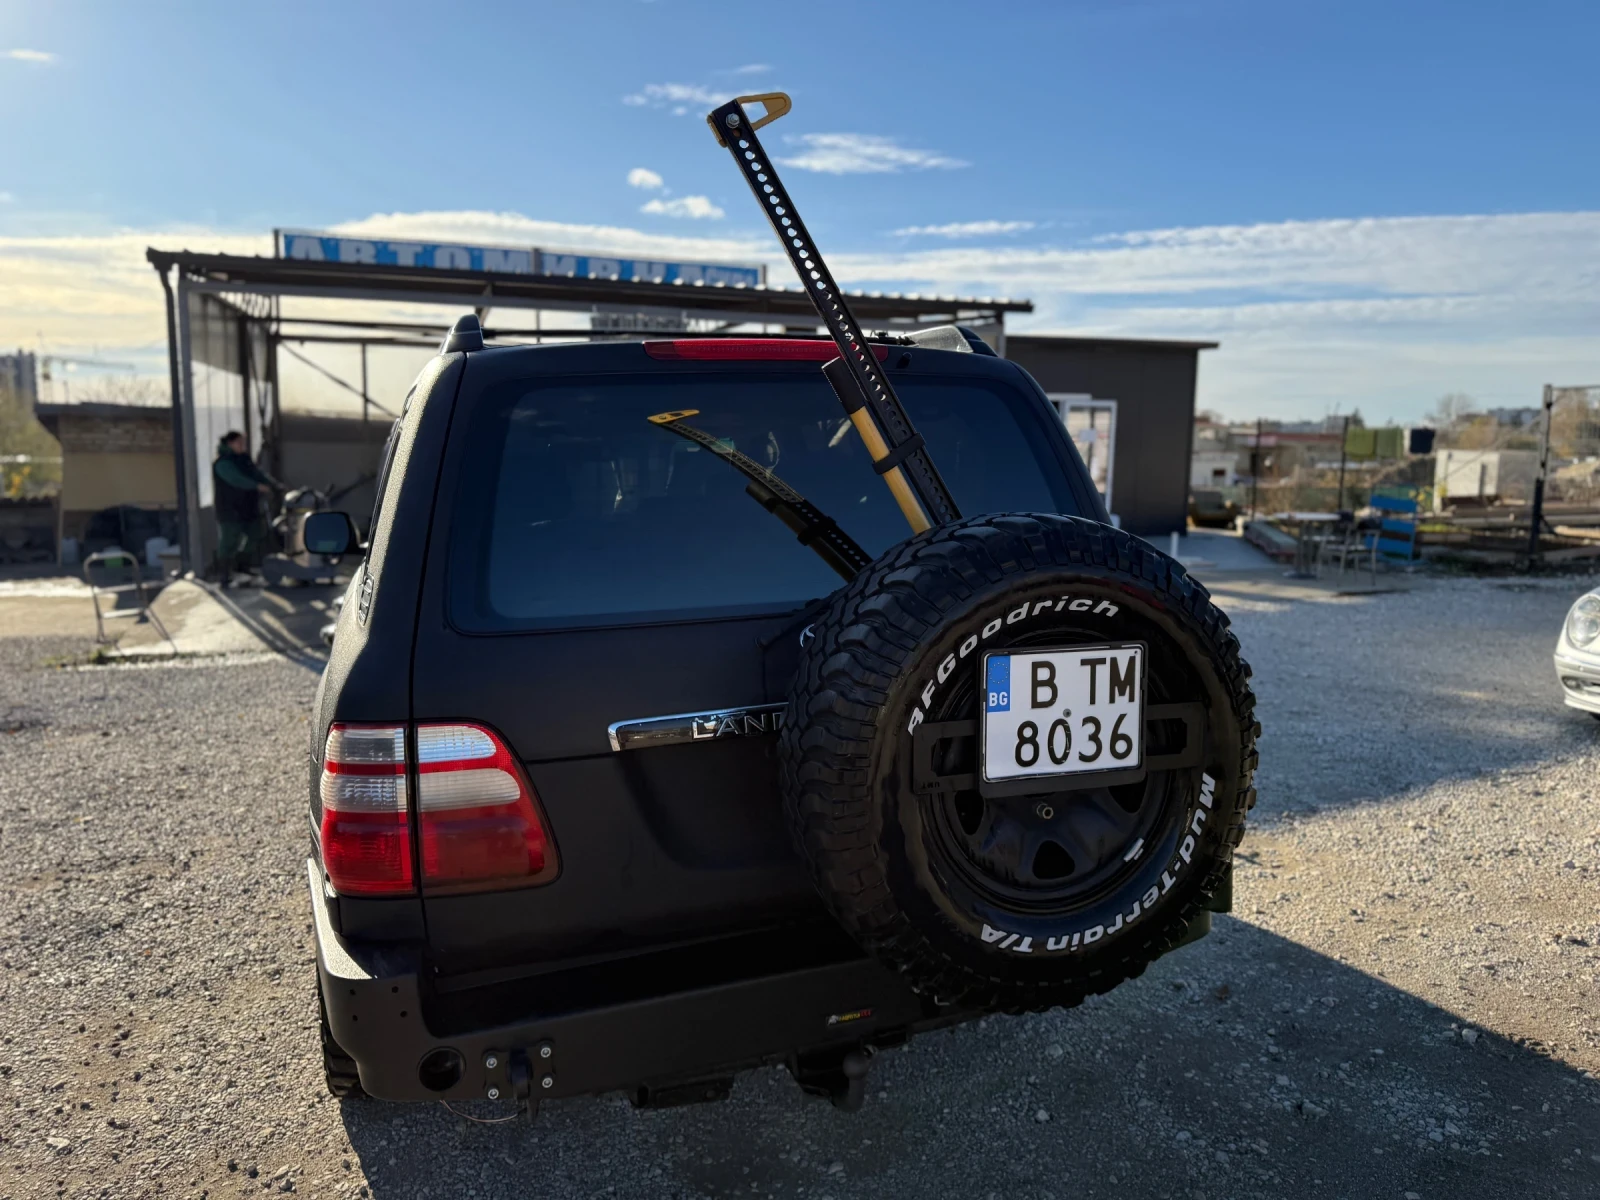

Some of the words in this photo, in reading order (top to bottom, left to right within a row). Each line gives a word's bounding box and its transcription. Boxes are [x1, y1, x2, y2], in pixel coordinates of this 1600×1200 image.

[908, 596, 1119, 735] BFGoodrich
[1030, 661, 1058, 709] B
[1080, 656, 1136, 705] TM
[989, 692, 1008, 707] BG
[1014, 713, 1134, 768] 8036
[1046, 772, 1216, 952] Mud-Terrain
[980, 923, 1033, 953] T/A
